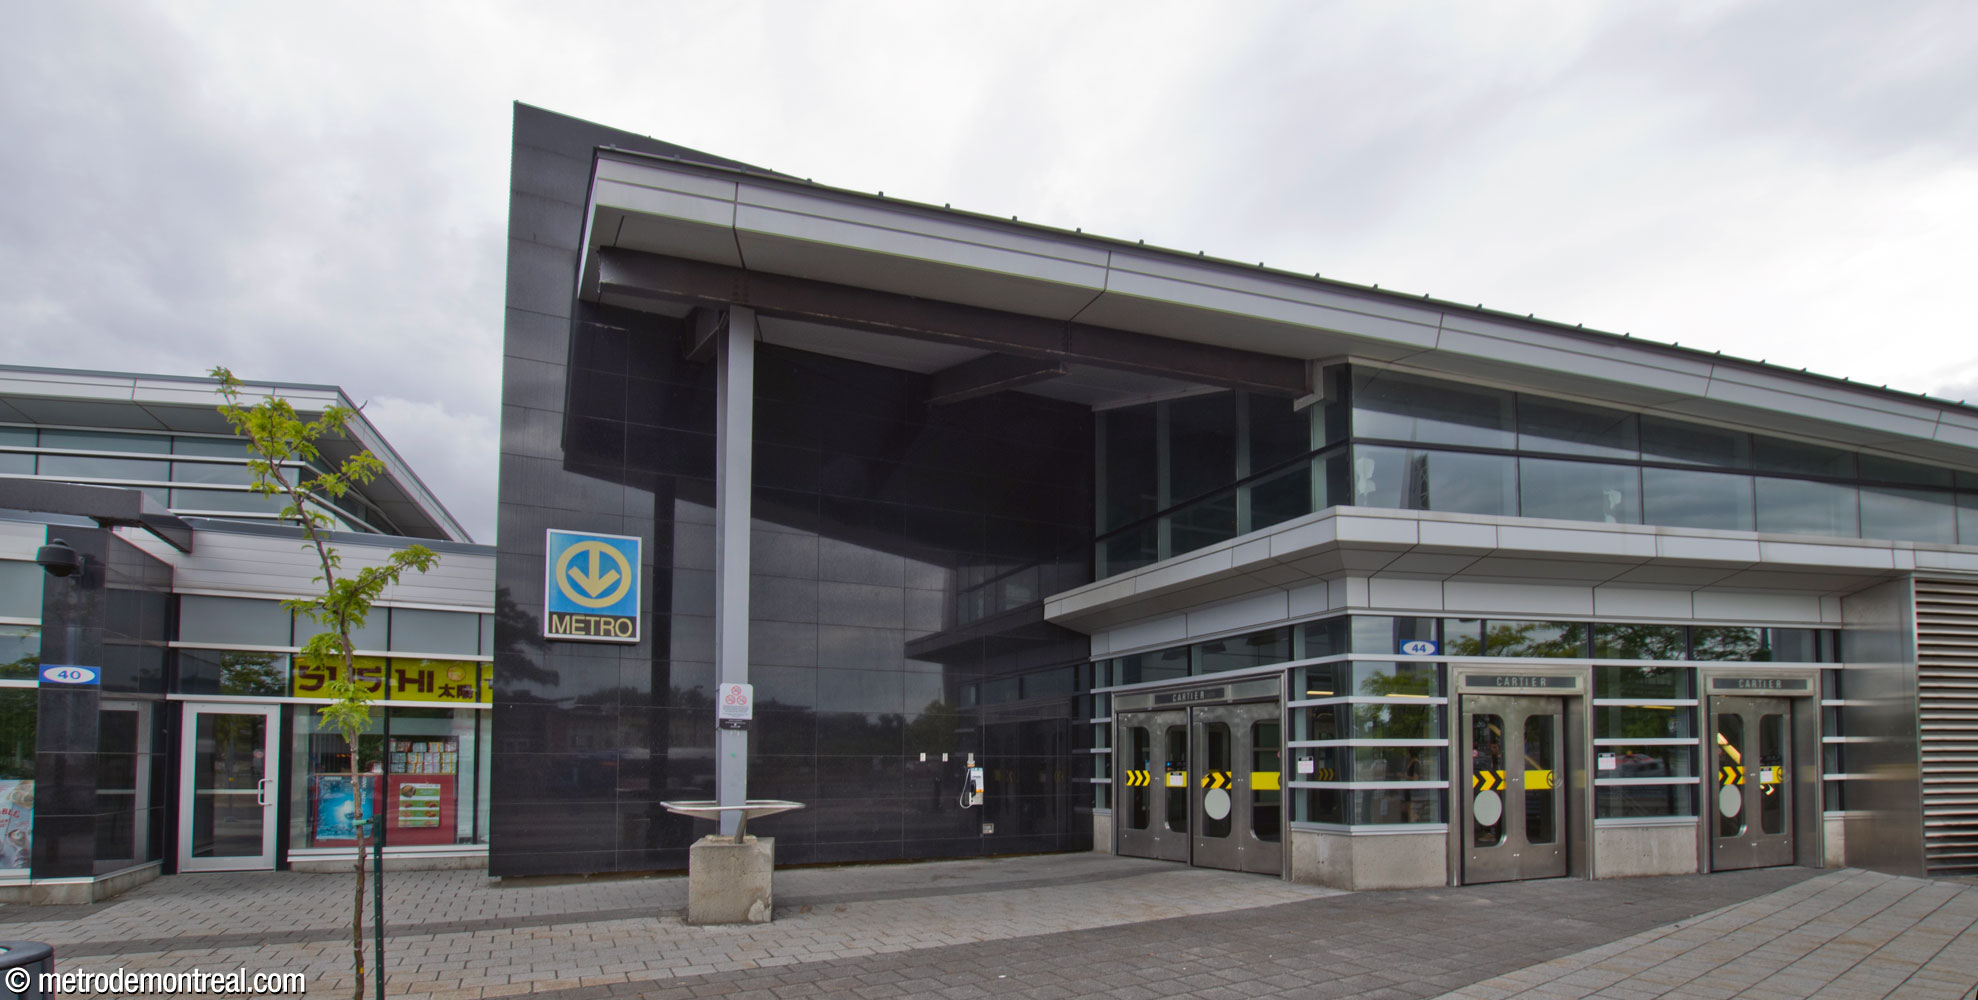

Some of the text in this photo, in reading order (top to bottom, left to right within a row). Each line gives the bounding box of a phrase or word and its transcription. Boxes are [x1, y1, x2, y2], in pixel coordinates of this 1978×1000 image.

[552, 614, 632, 637] METRO
[1412, 643, 1426, 653] 44
[57, 670, 81, 680] 40
[1496, 676, 1547, 687] CARTIER
[1738, 679, 1783, 689] CARTIER
[1172, 690, 1205, 702] CARTIER
